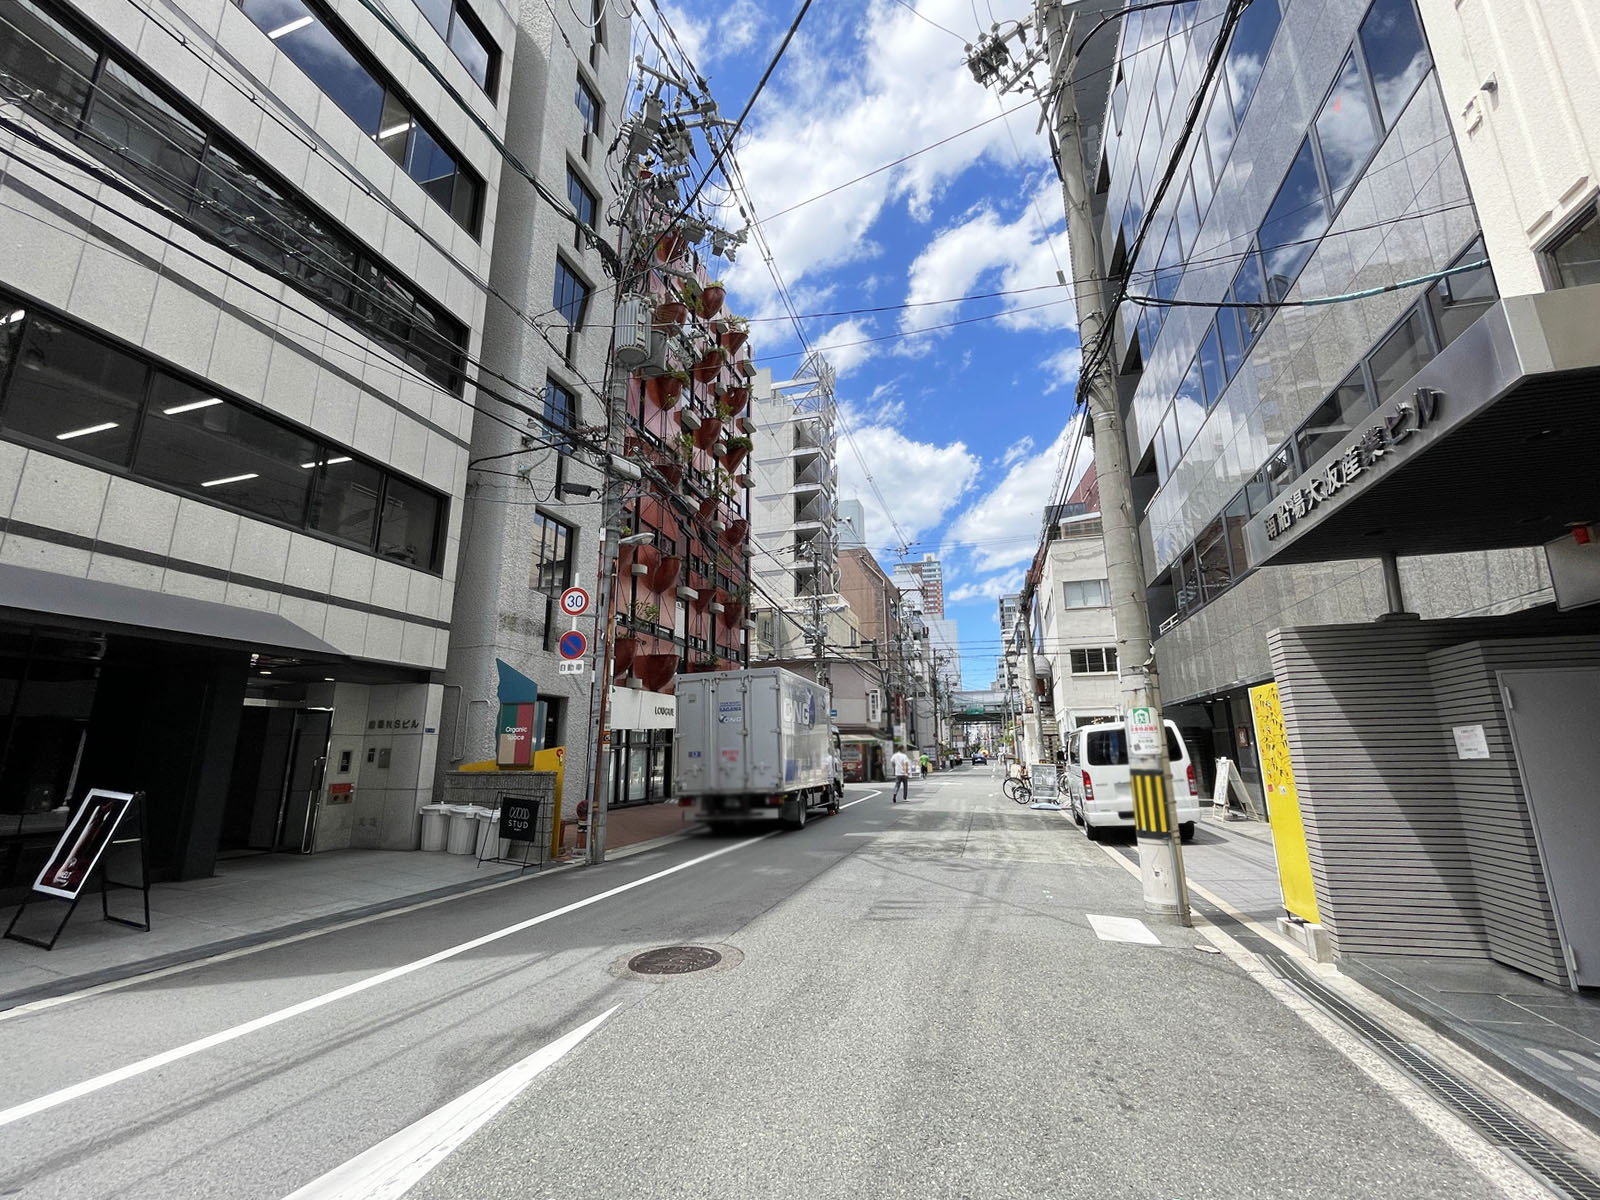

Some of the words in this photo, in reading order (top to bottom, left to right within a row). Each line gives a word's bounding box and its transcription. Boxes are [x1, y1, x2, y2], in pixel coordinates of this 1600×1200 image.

[1263, 387, 1447, 542] 南船場大阪産業ビル
[567, 595, 584, 608] 30
[784, 698, 810, 725] CNG
[508, 819, 529, 829] STUD
